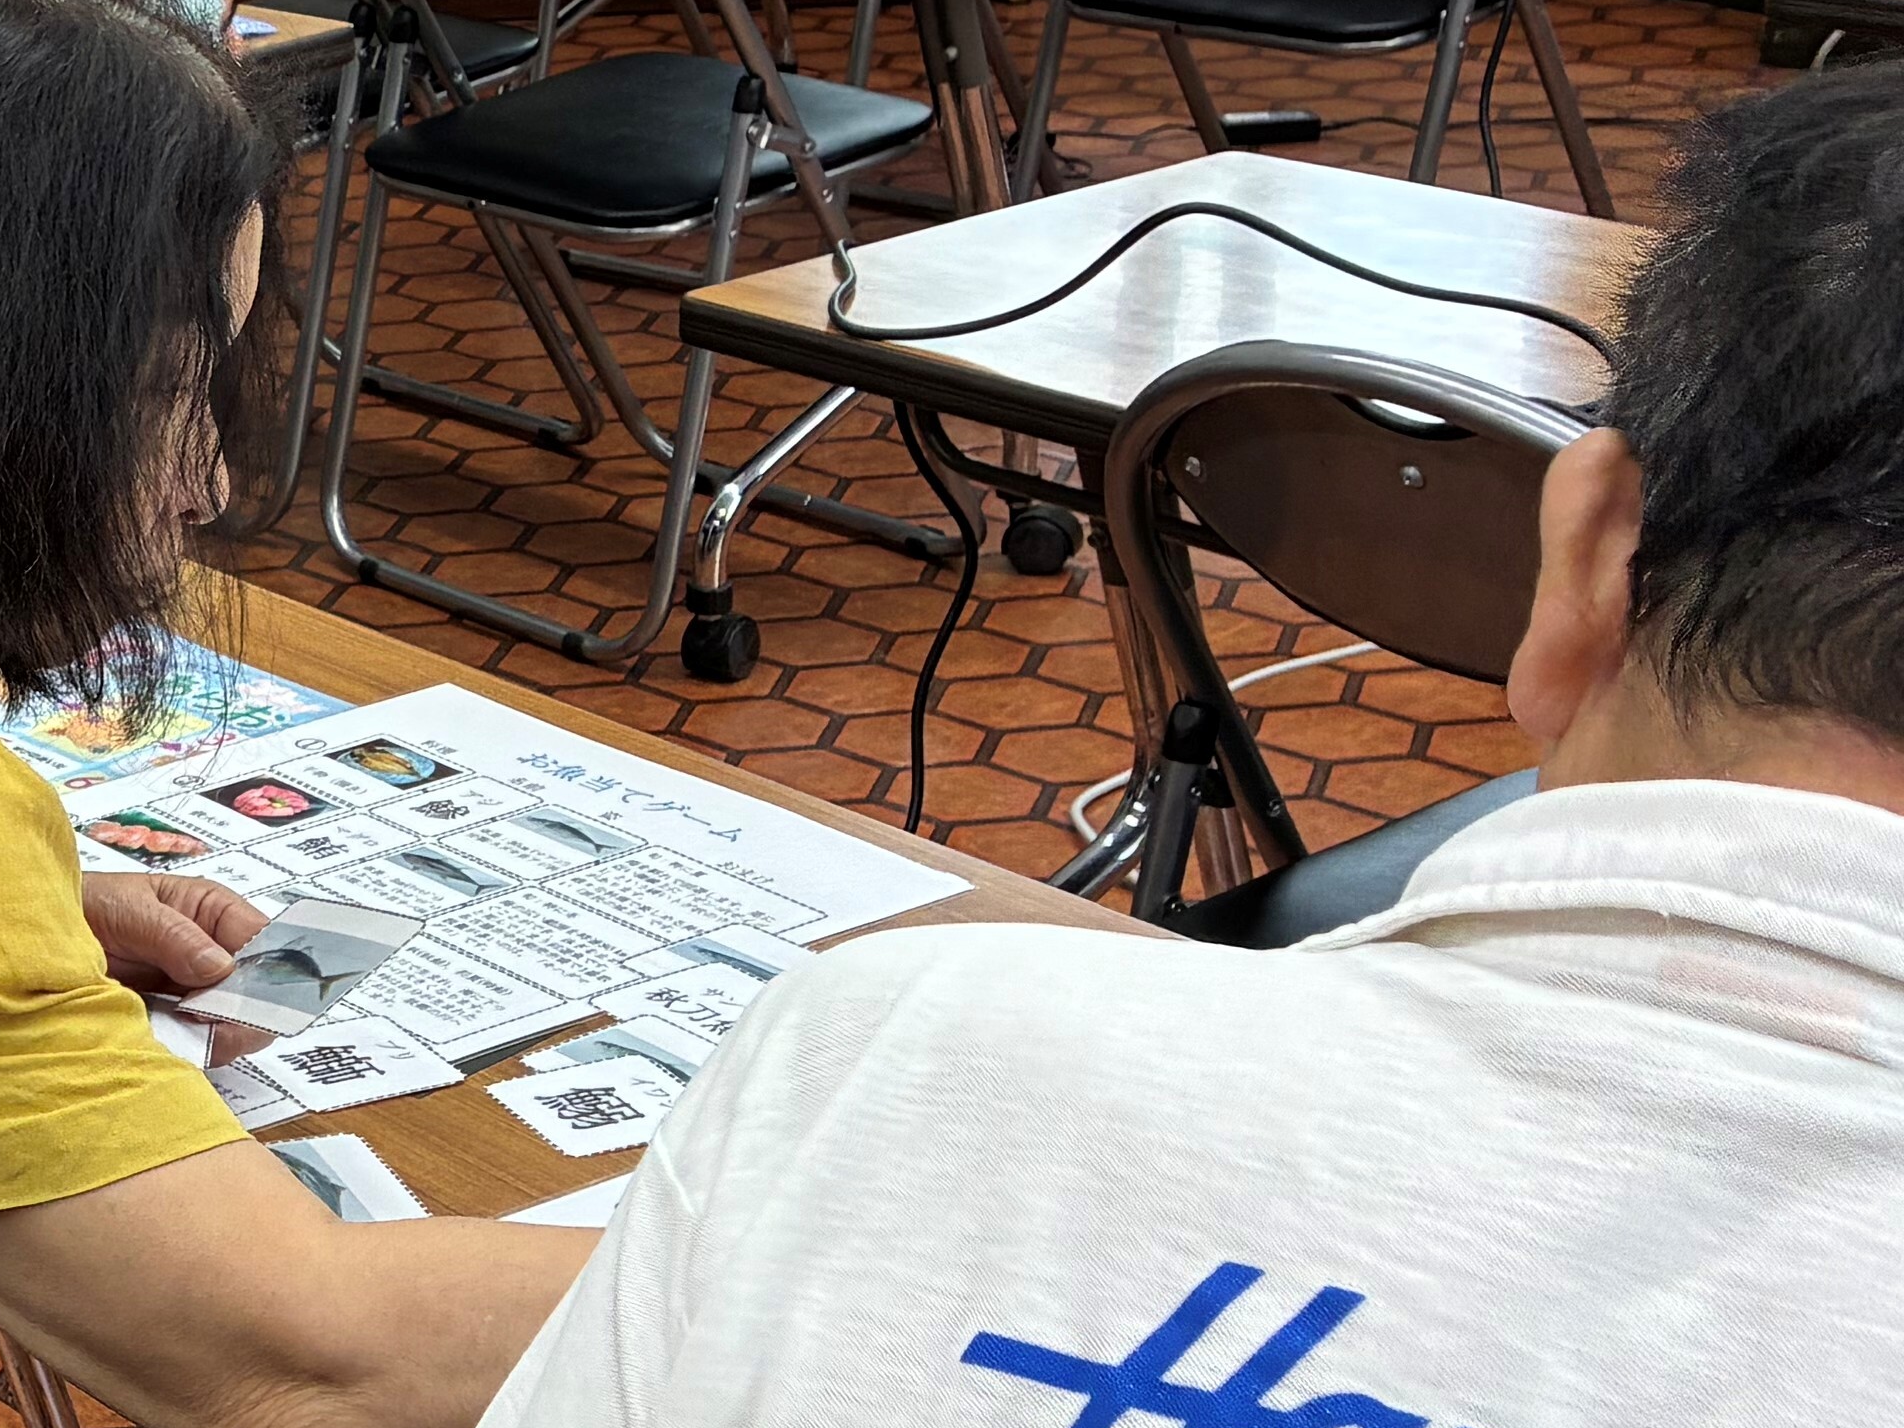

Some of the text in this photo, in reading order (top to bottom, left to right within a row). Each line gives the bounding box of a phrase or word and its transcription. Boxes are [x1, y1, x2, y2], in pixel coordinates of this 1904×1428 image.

[516, 752, 743, 843] お魚当てゲーム
[290, 834, 349, 860] 鮪
[277, 1044, 386, 1085] 鰤
[534, 1086, 645, 1129] 鰯
